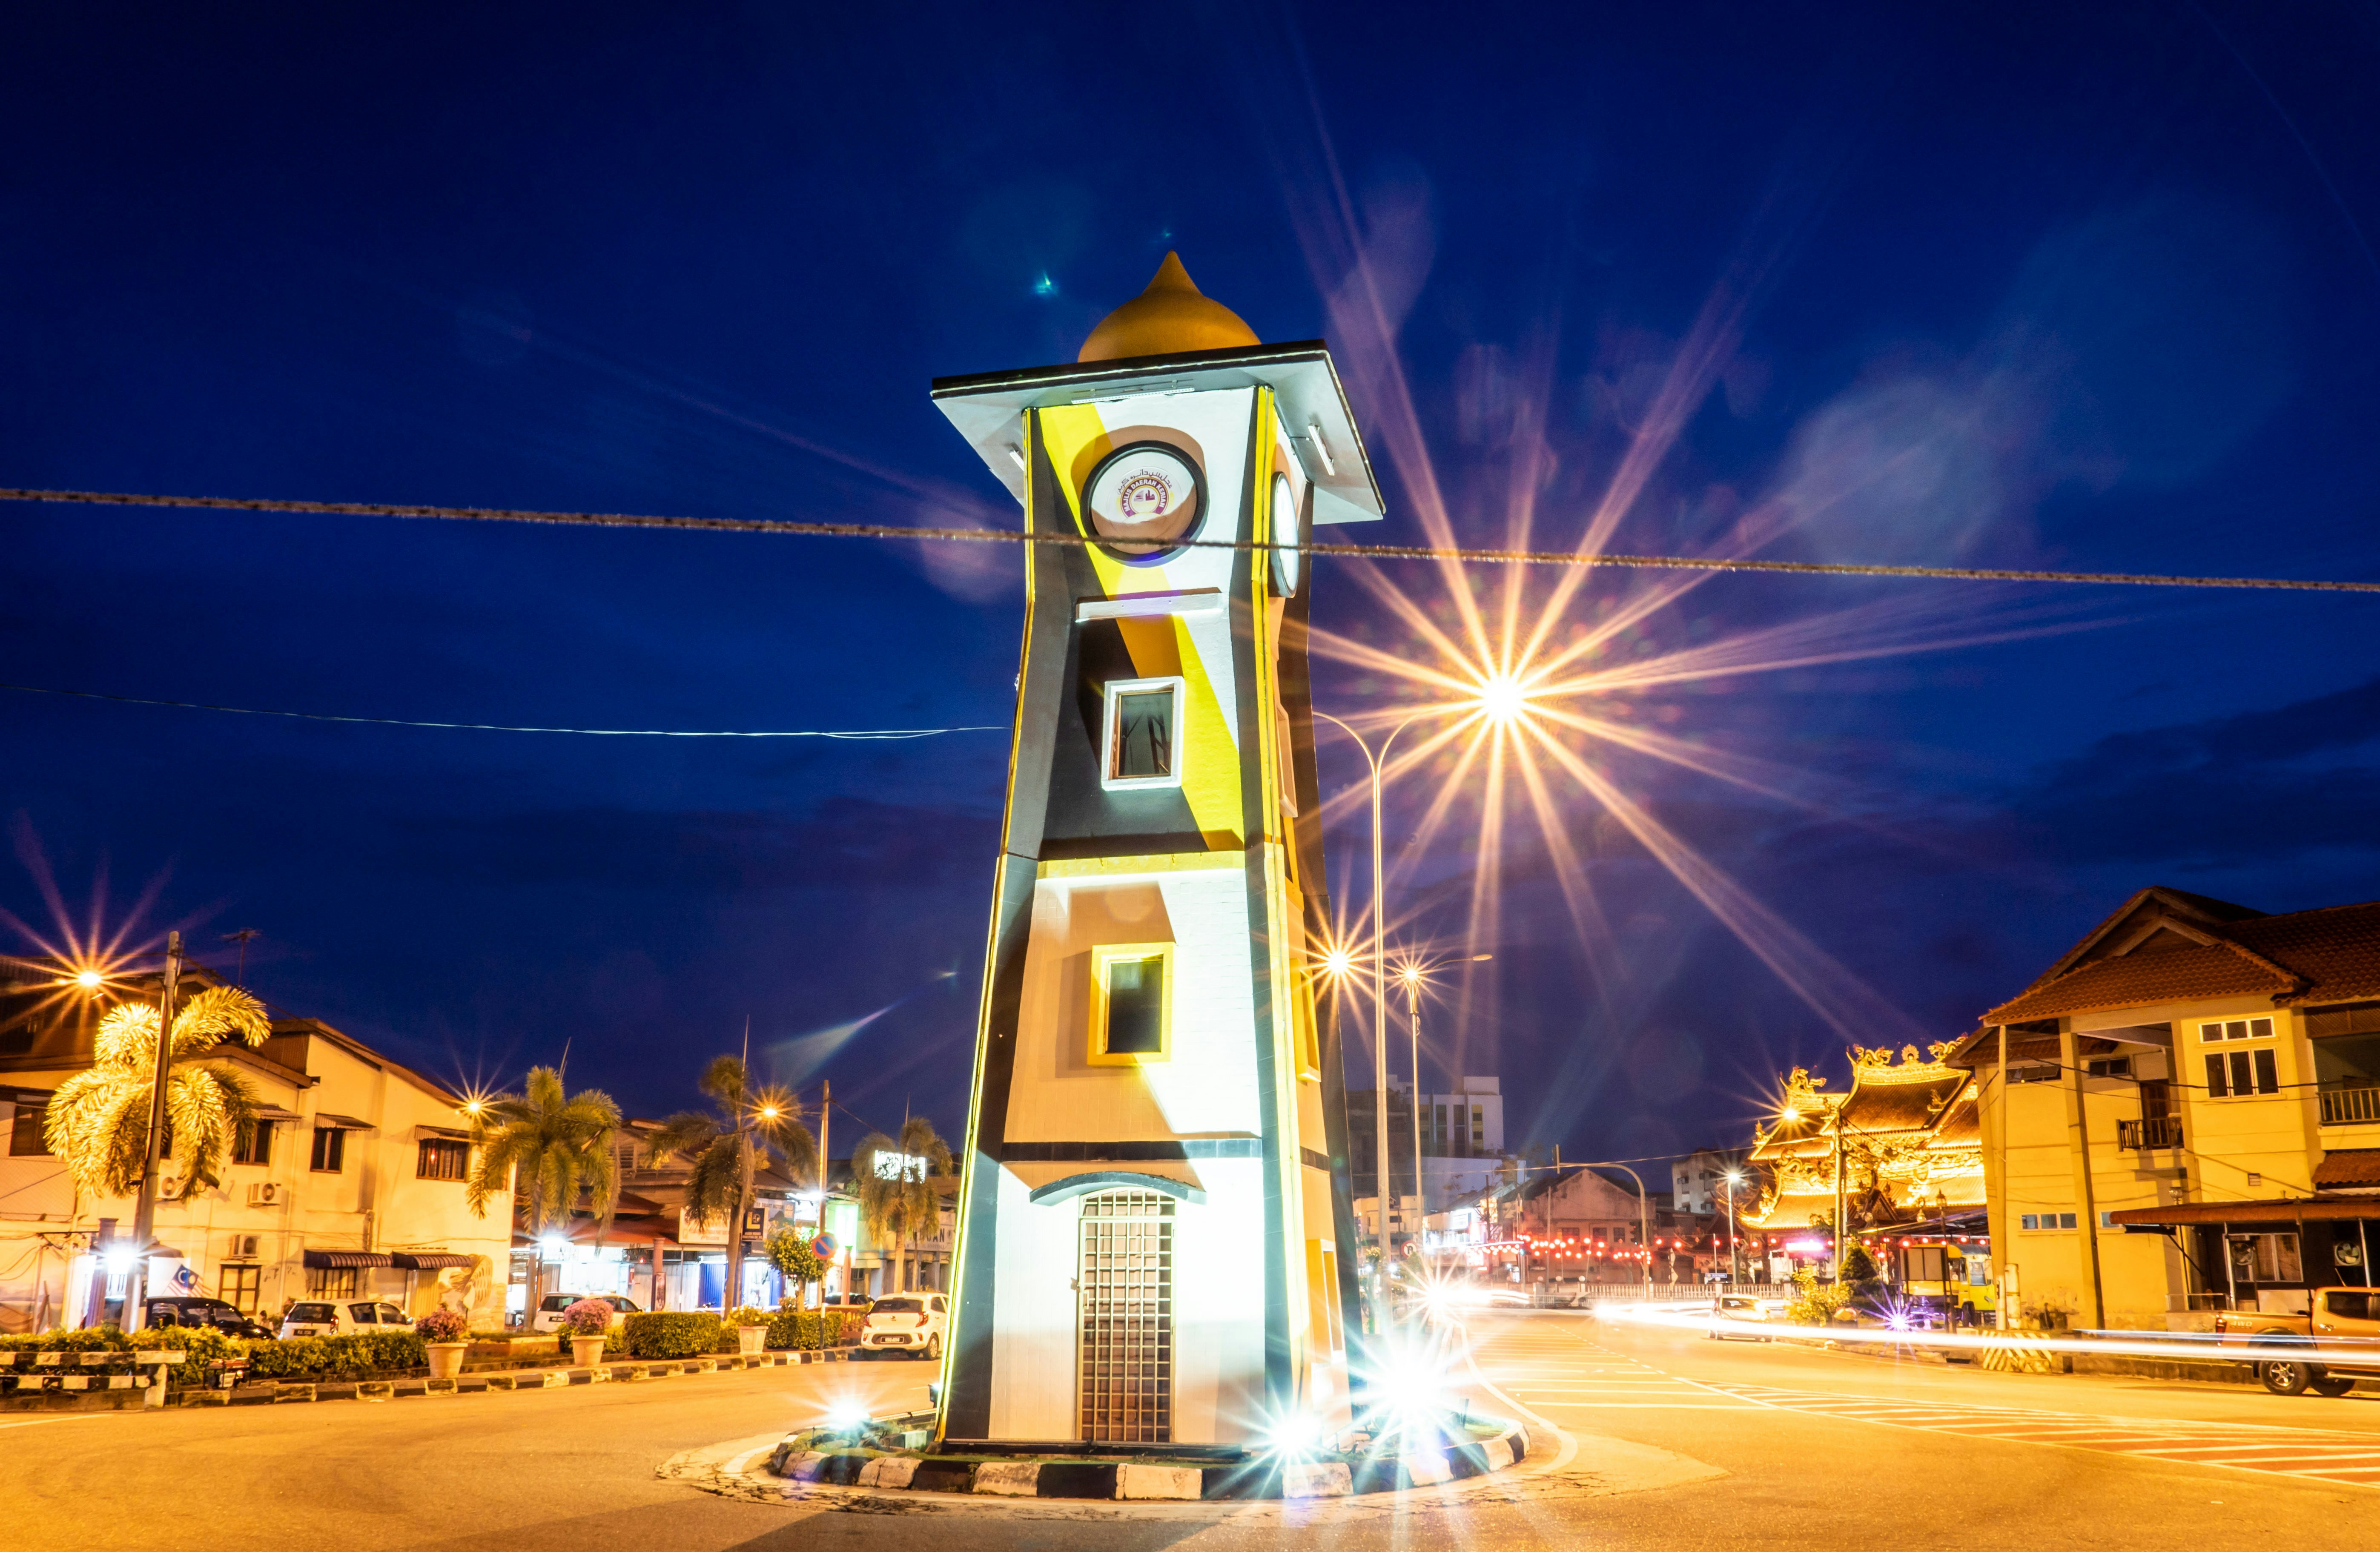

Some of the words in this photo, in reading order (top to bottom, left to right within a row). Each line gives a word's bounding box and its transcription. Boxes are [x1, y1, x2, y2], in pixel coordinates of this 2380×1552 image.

[1123, 488, 1132, 512] MAJLIS
[1130, 479, 1157, 489] DAERAH
[1156, 483, 1166, 508] KERIAN
[746, 1211, 760, 1229] L
